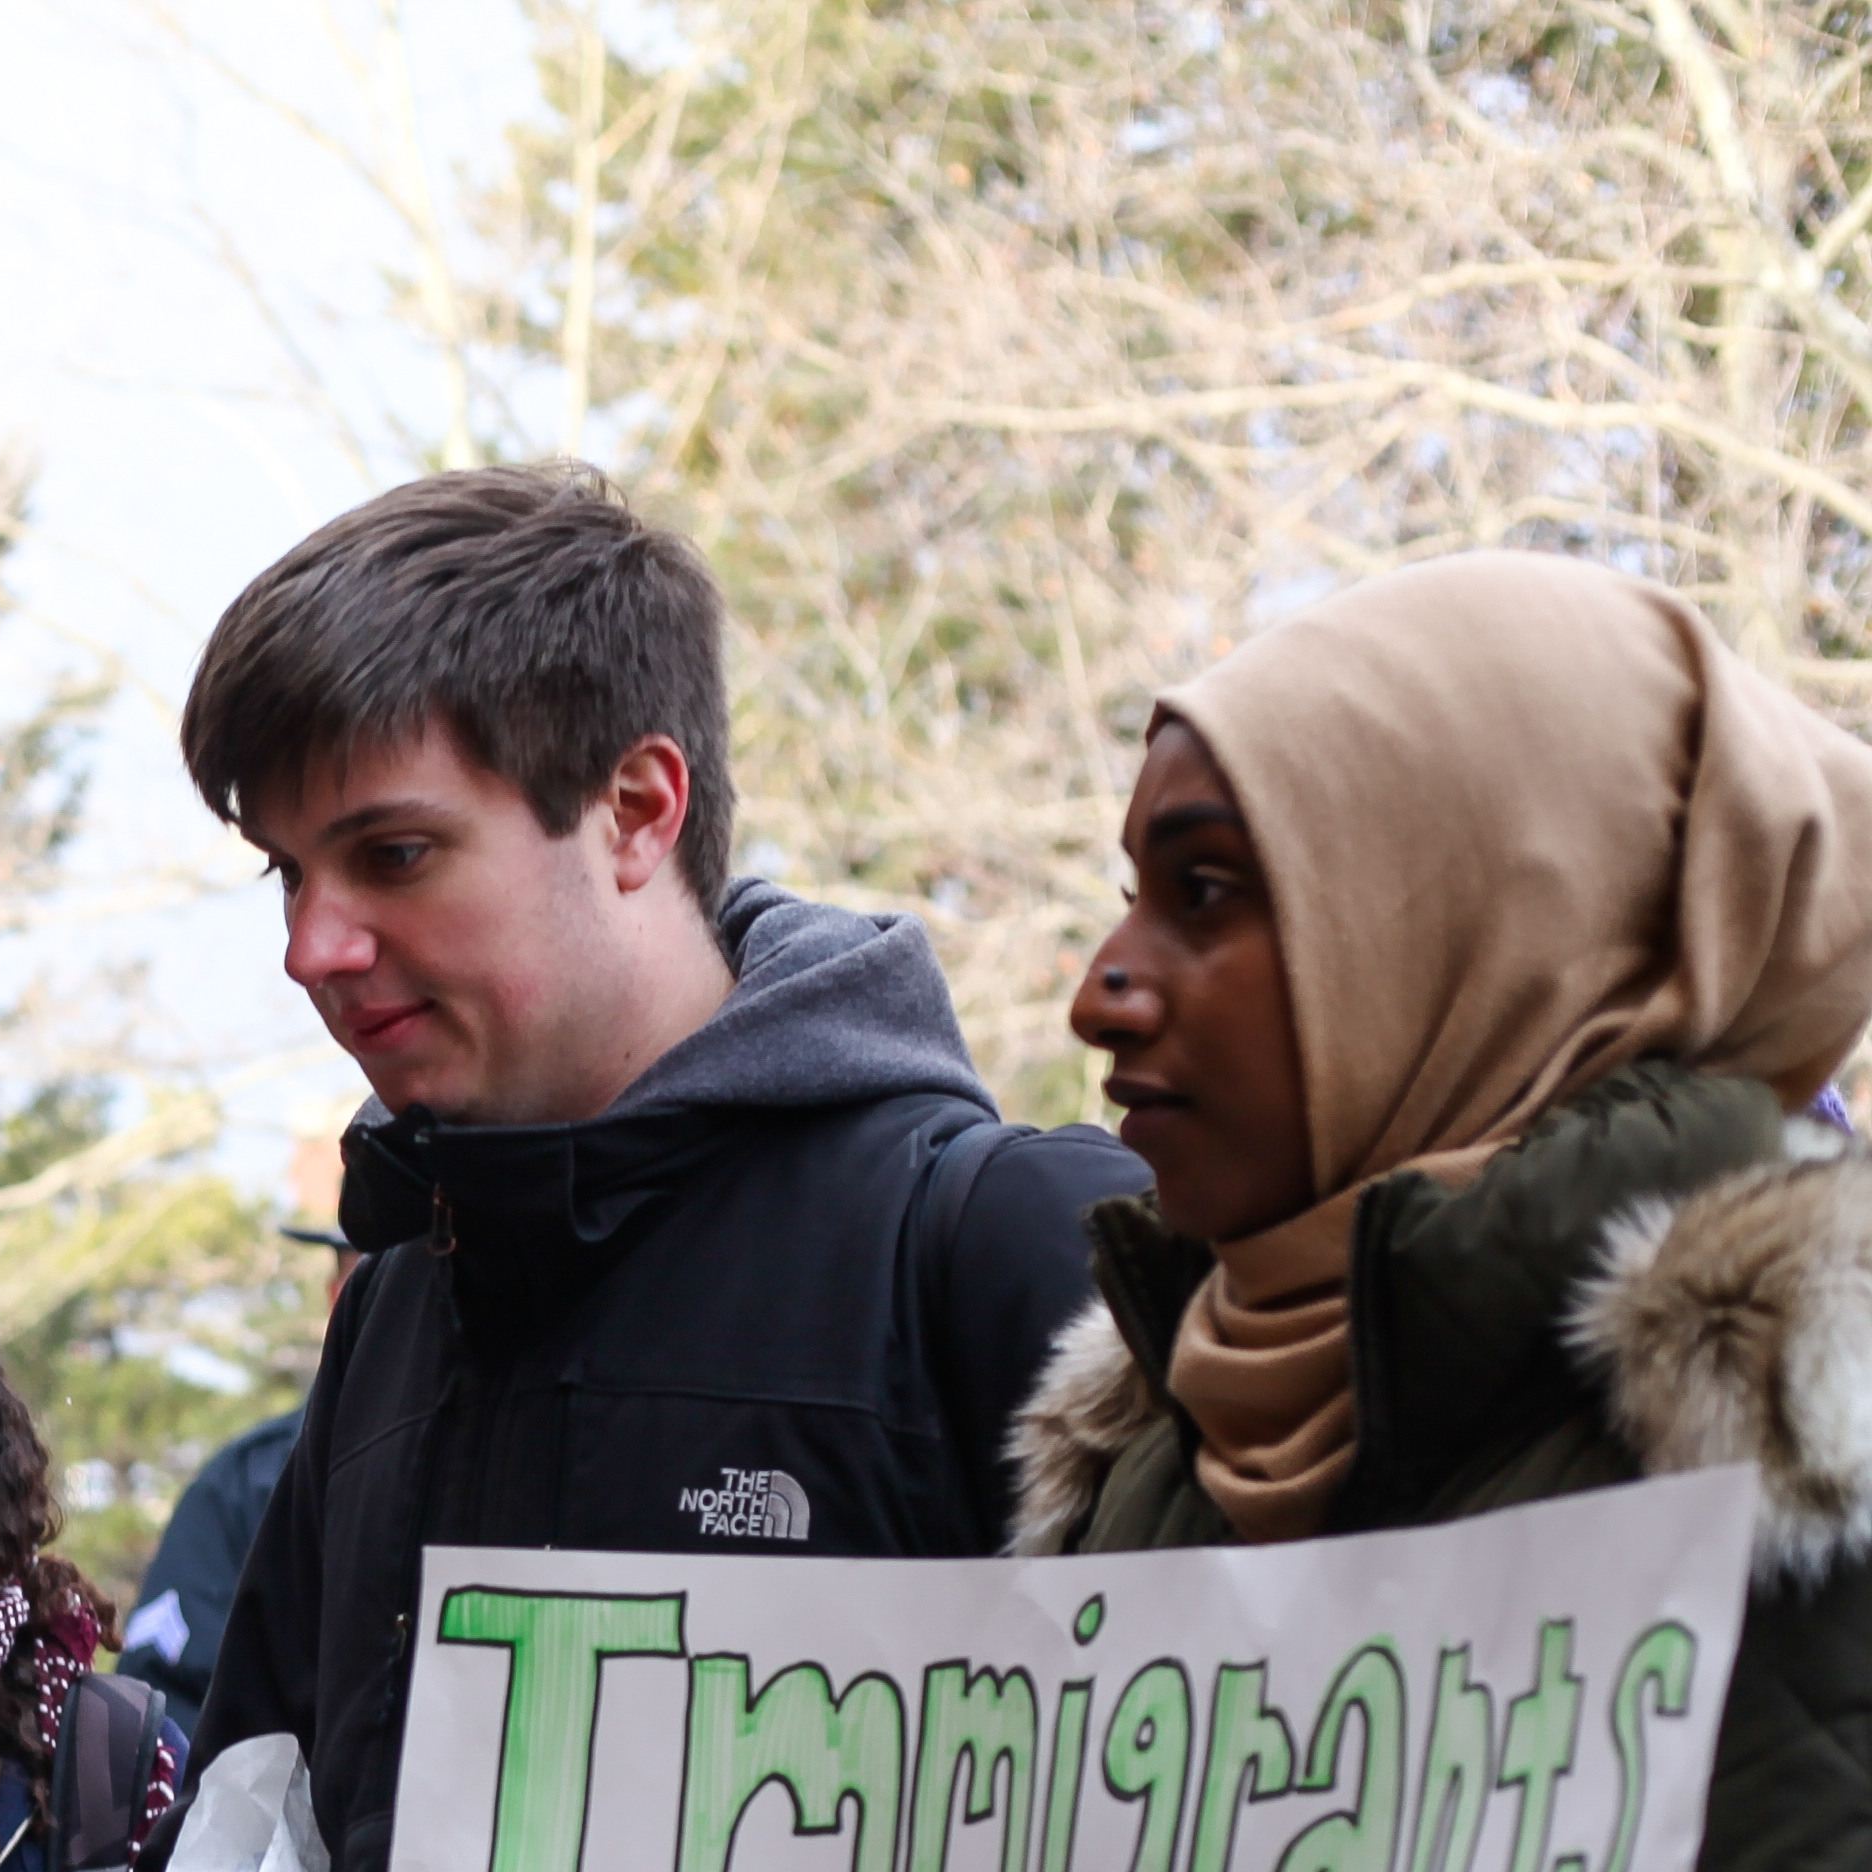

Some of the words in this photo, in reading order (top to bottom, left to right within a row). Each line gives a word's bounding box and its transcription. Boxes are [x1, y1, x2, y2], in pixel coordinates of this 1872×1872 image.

[720, 1467, 770, 1492] THE
[678, 1487, 768, 1514] NORTH
[699, 1512, 763, 1537] FACE
